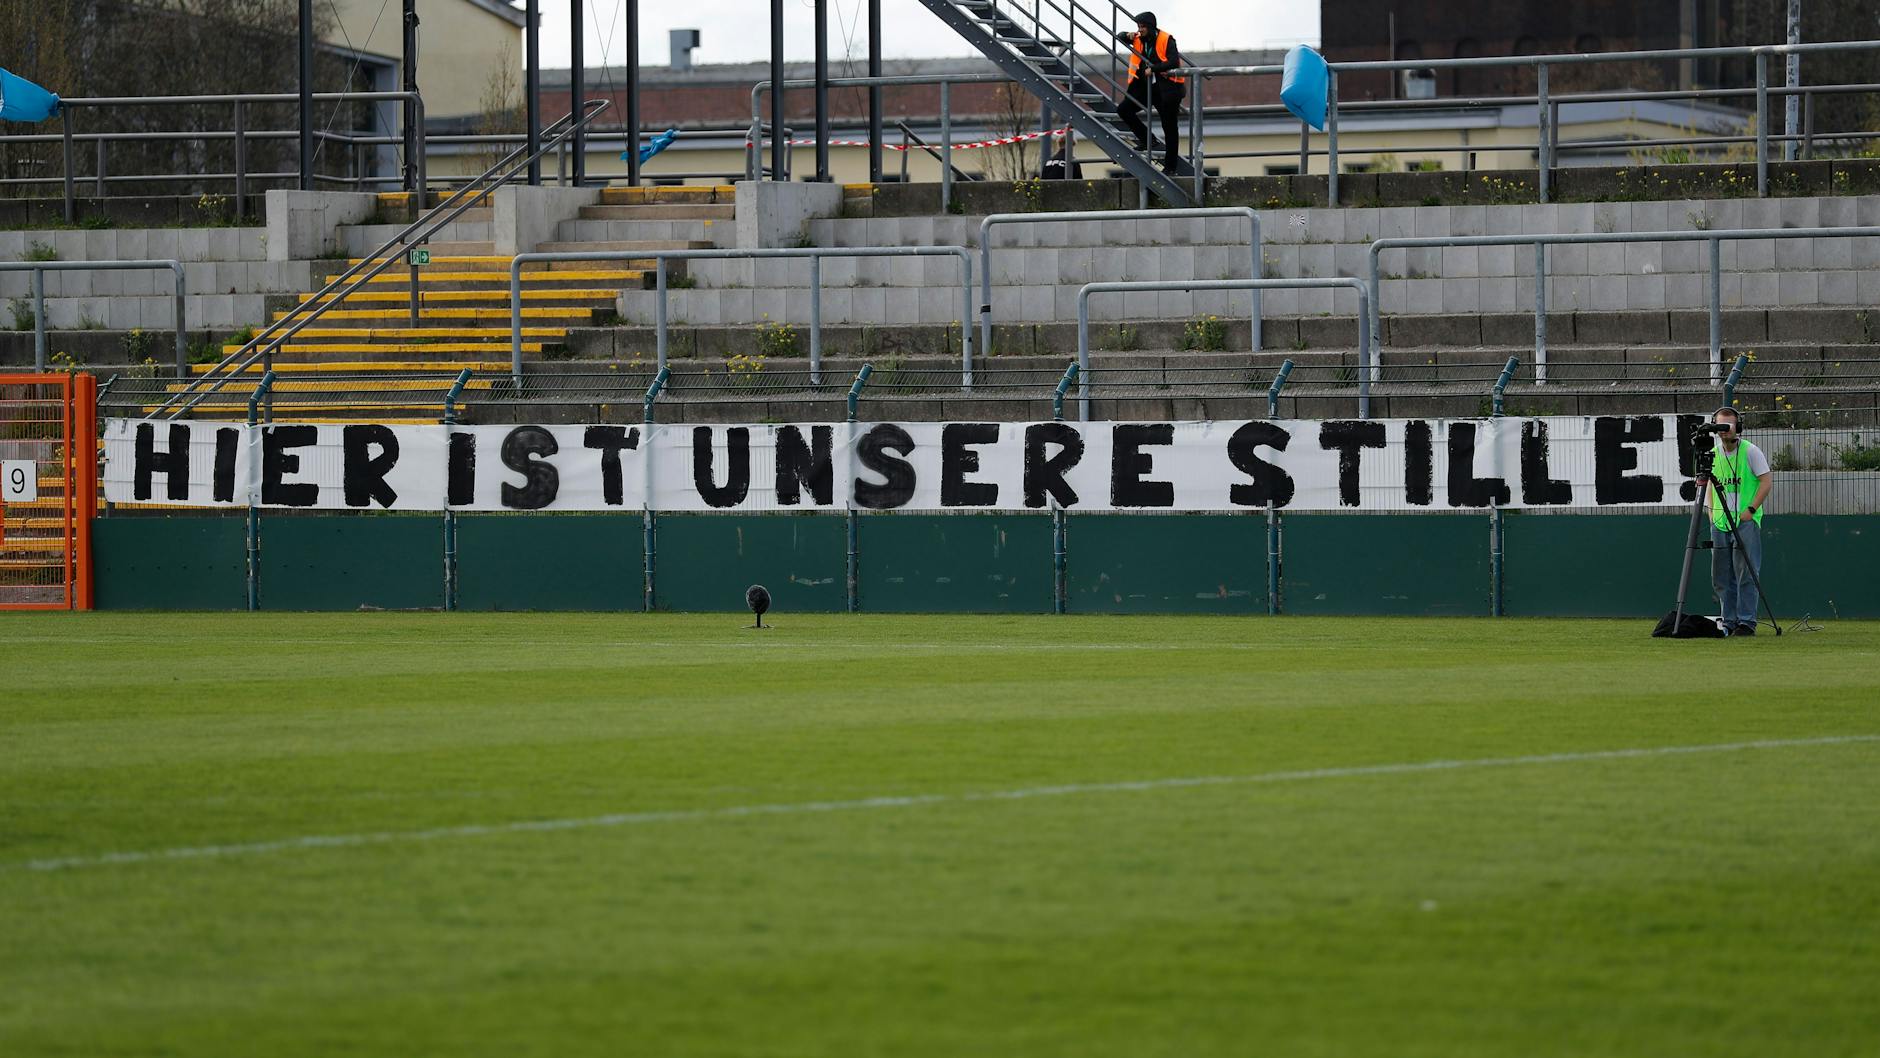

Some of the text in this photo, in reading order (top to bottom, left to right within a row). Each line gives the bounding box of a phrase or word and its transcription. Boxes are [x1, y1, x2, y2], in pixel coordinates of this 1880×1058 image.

[11, 468, 25, 494] 9
[133, 415, 1705, 509] HIER IST UNSERE STILLE!
